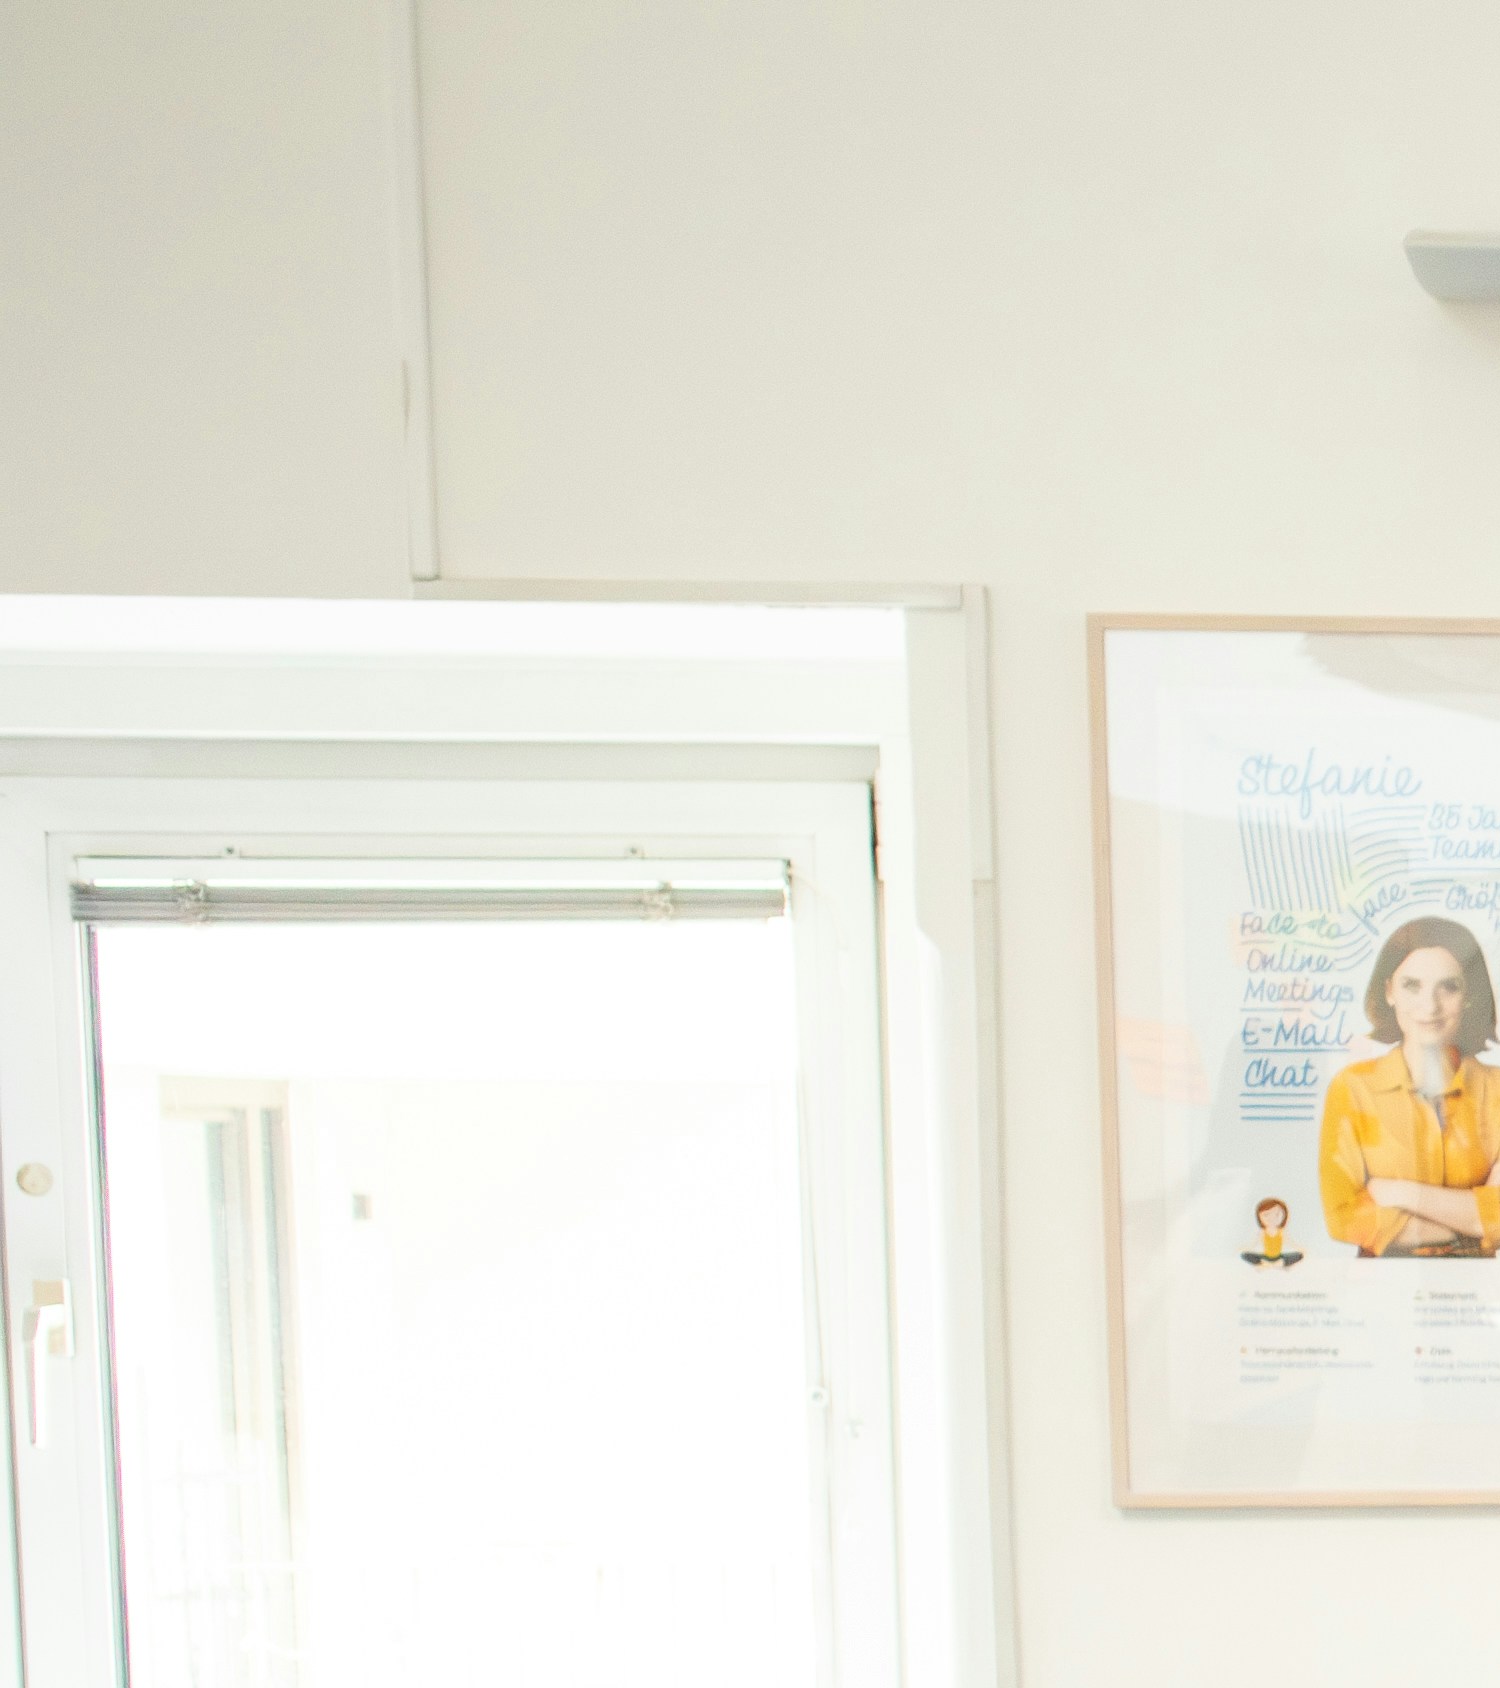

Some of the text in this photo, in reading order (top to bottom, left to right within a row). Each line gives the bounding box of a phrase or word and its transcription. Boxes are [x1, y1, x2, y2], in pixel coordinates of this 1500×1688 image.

[1236, 748, 1423, 820] Stefanie
[1427, 802, 1462, 832] 35
[1240, 912, 1299, 939] Face
[1350, 881, 1409, 936] face
[1246, 946, 1338, 974] Online
[1243, 976, 1355, 1019] Meetings
[1240, 1010, 1355, 1047] E-Mail
[1244, 1057, 1320, 1089] Chat
